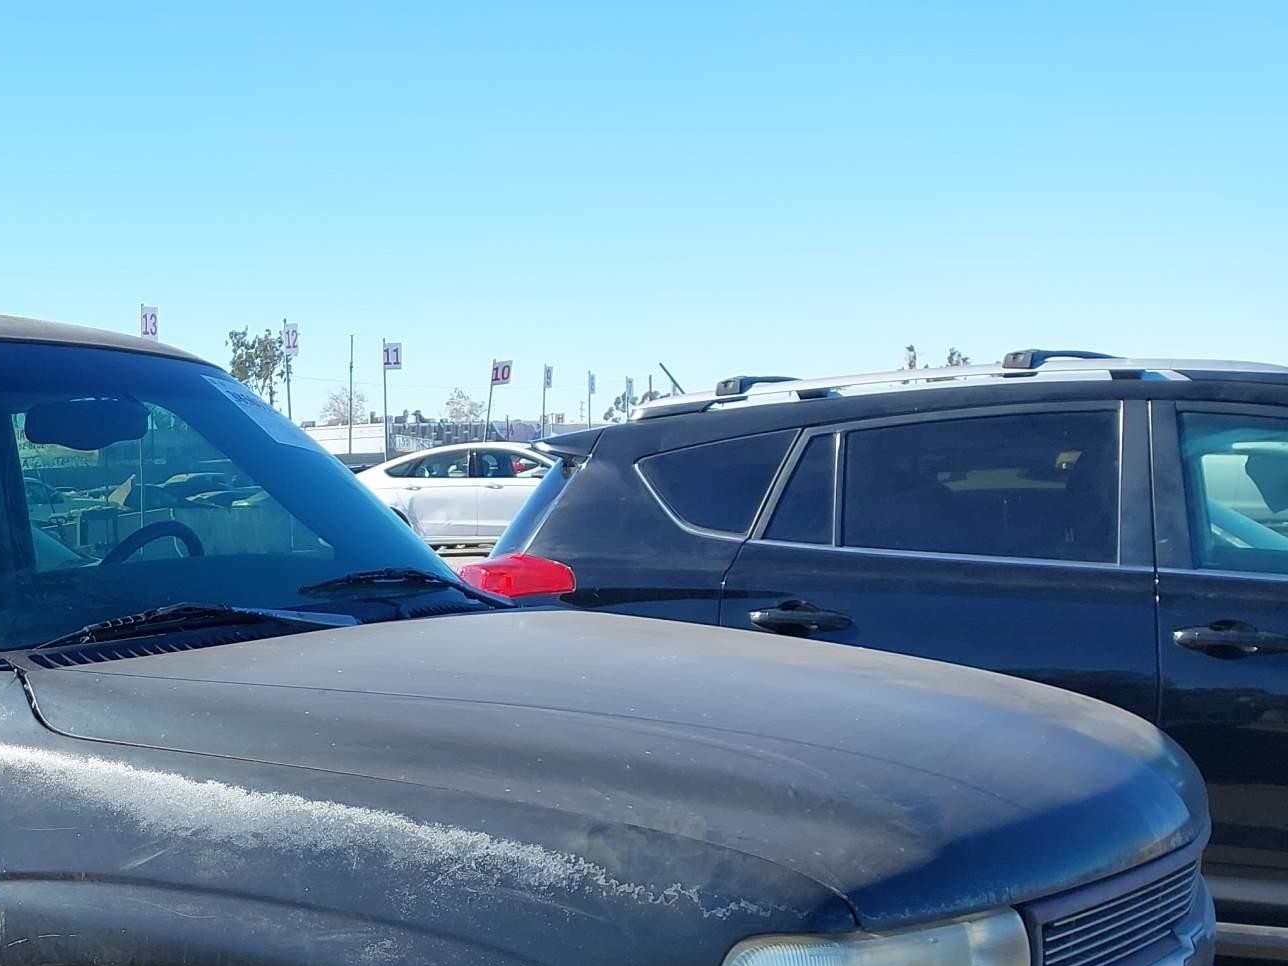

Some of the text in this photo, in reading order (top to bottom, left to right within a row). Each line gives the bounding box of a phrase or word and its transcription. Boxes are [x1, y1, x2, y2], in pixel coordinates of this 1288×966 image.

[142, 313, 158, 336] 13
[286, 329, 298, 349] 12
[383, 347, 401, 366] 11
[492, 365, 511, 381] 10
